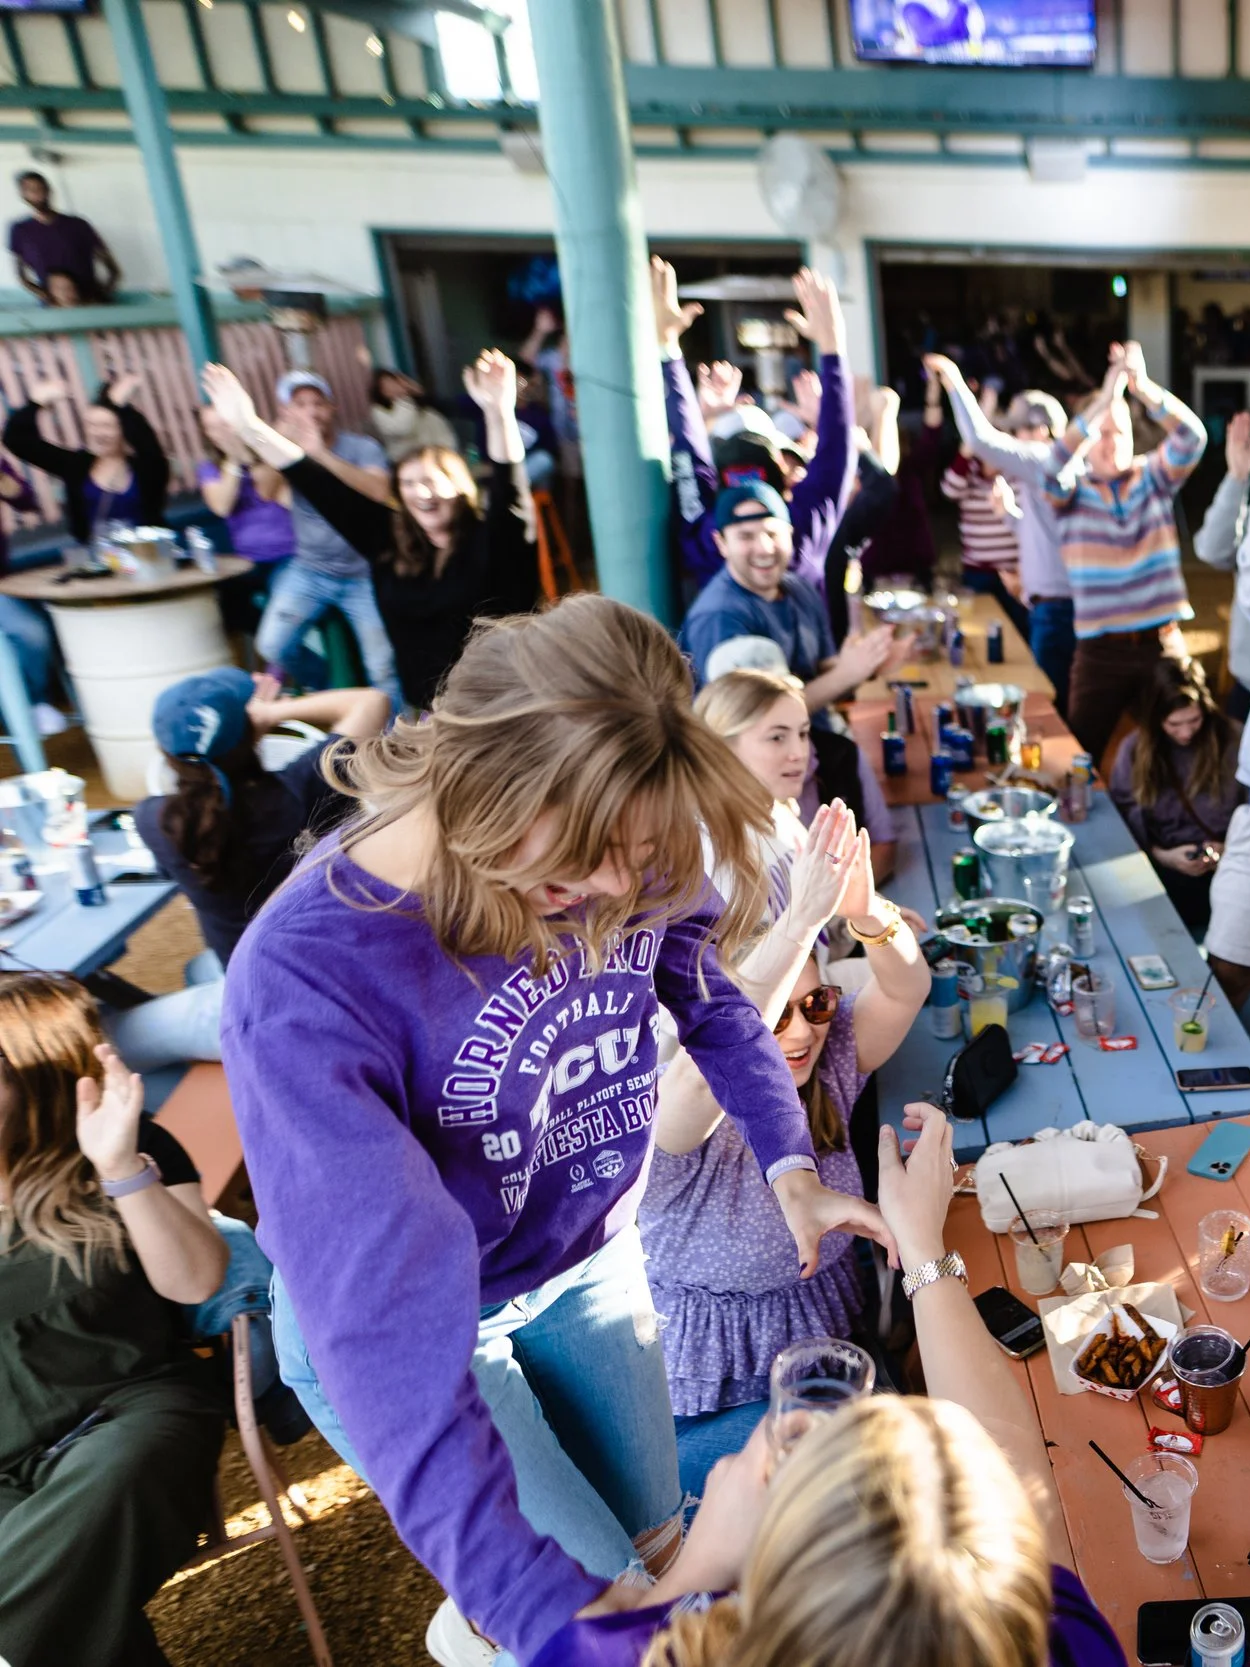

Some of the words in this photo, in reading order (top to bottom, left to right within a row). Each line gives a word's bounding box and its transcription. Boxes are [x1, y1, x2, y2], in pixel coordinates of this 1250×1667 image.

[437, 947, 570, 1127] HORNED
[518, 990, 635, 1077] FOOTBALL
[529, 1105, 622, 1176] FIESTA
[618, 1088, 657, 1133] BO
[576, 1082, 623, 1113] PLAYOFF
[481, 1129, 522, 1162] 20
